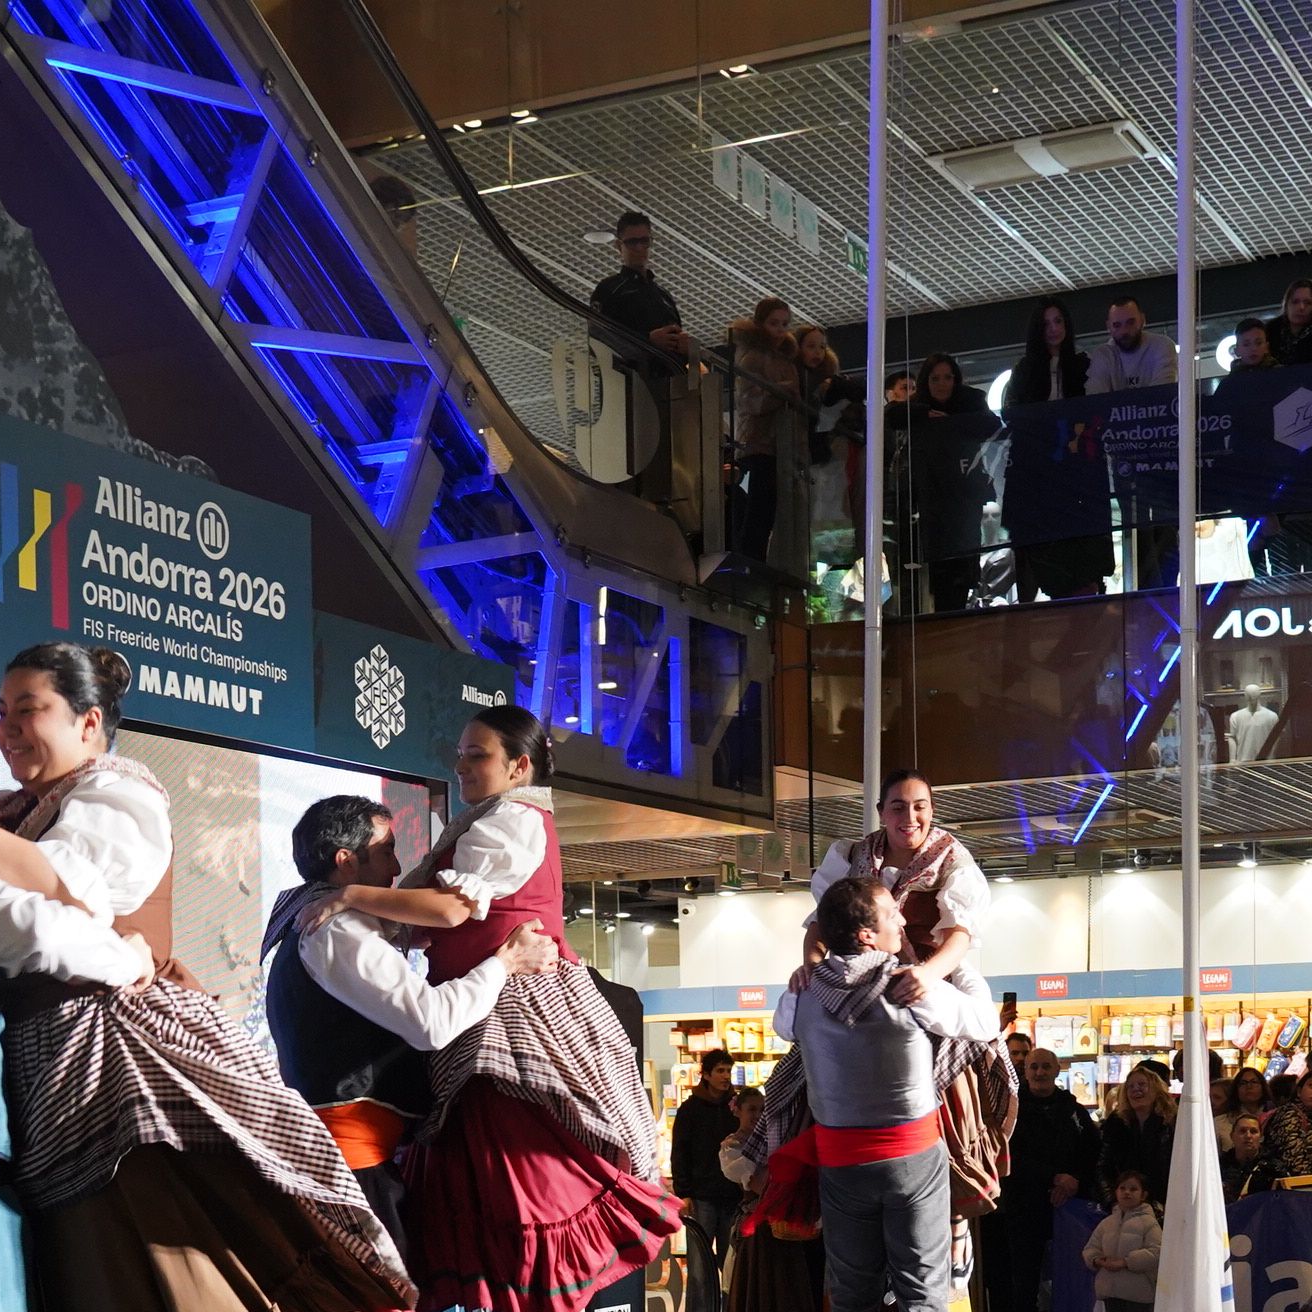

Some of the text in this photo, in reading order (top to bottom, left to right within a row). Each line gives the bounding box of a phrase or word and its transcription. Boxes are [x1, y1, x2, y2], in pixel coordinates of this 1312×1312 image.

[1109, 405, 1168, 422] Allianz
[94, 475, 192, 541] Allianz
[81, 528, 286, 621] Andorra 2026
[82, 581, 244, 642] ORDINO ARCALÍS
[83, 617, 288, 684] FIS Freeride World Championships
[138, 664, 263, 715] MAMMUT
[461, 684, 494, 707] Allianz
